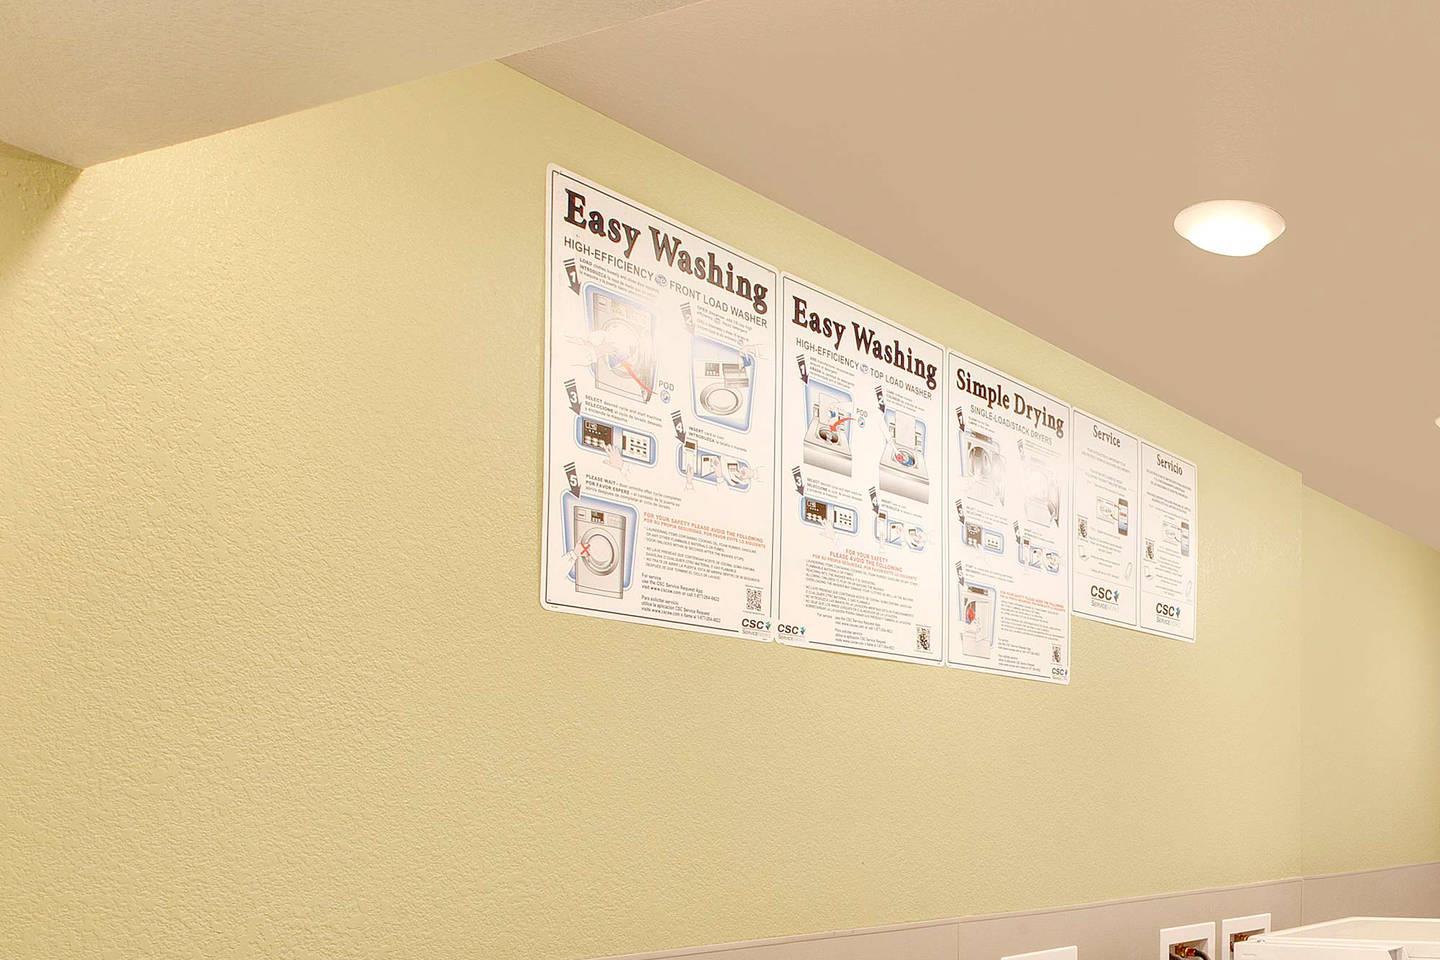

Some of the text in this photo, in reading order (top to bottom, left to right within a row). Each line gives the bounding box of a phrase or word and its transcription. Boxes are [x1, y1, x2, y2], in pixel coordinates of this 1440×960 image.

[563, 188, 768, 315] Easy Washing
[564, 236, 654, 281] HIGH-EFFICIENCY
[670, 281, 700, 302] FRONT
[703, 294, 728, 313] LOAD
[730, 306, 768, 328] WASHER
[792, 295, 846, 350] Easy
[851, 321, 937, 390] Washing
[796, 337, 860, 370] HIGH-EFFICIENCY
[870, 367, 884, 380] TOP
[885, 375, 904, 389] LOAD
[905, 383, 932, 400] WASHER
[659, 380, 674, 392] POD
[956, 368, 1010, 409] Simple
[1013, 393, 1065, 439] Drying
[1093, 424, 1121, 448] Service
[1156, 454, 1183, 476] Servicio
[1091, 585, 1112, 600] CSC
[1156, 602, 1175, 616] CSC
[742, 618, 764, 630] CSC
[777, 624, 799, 635] CSC
[1052, 667, 1065, 676] CSC
